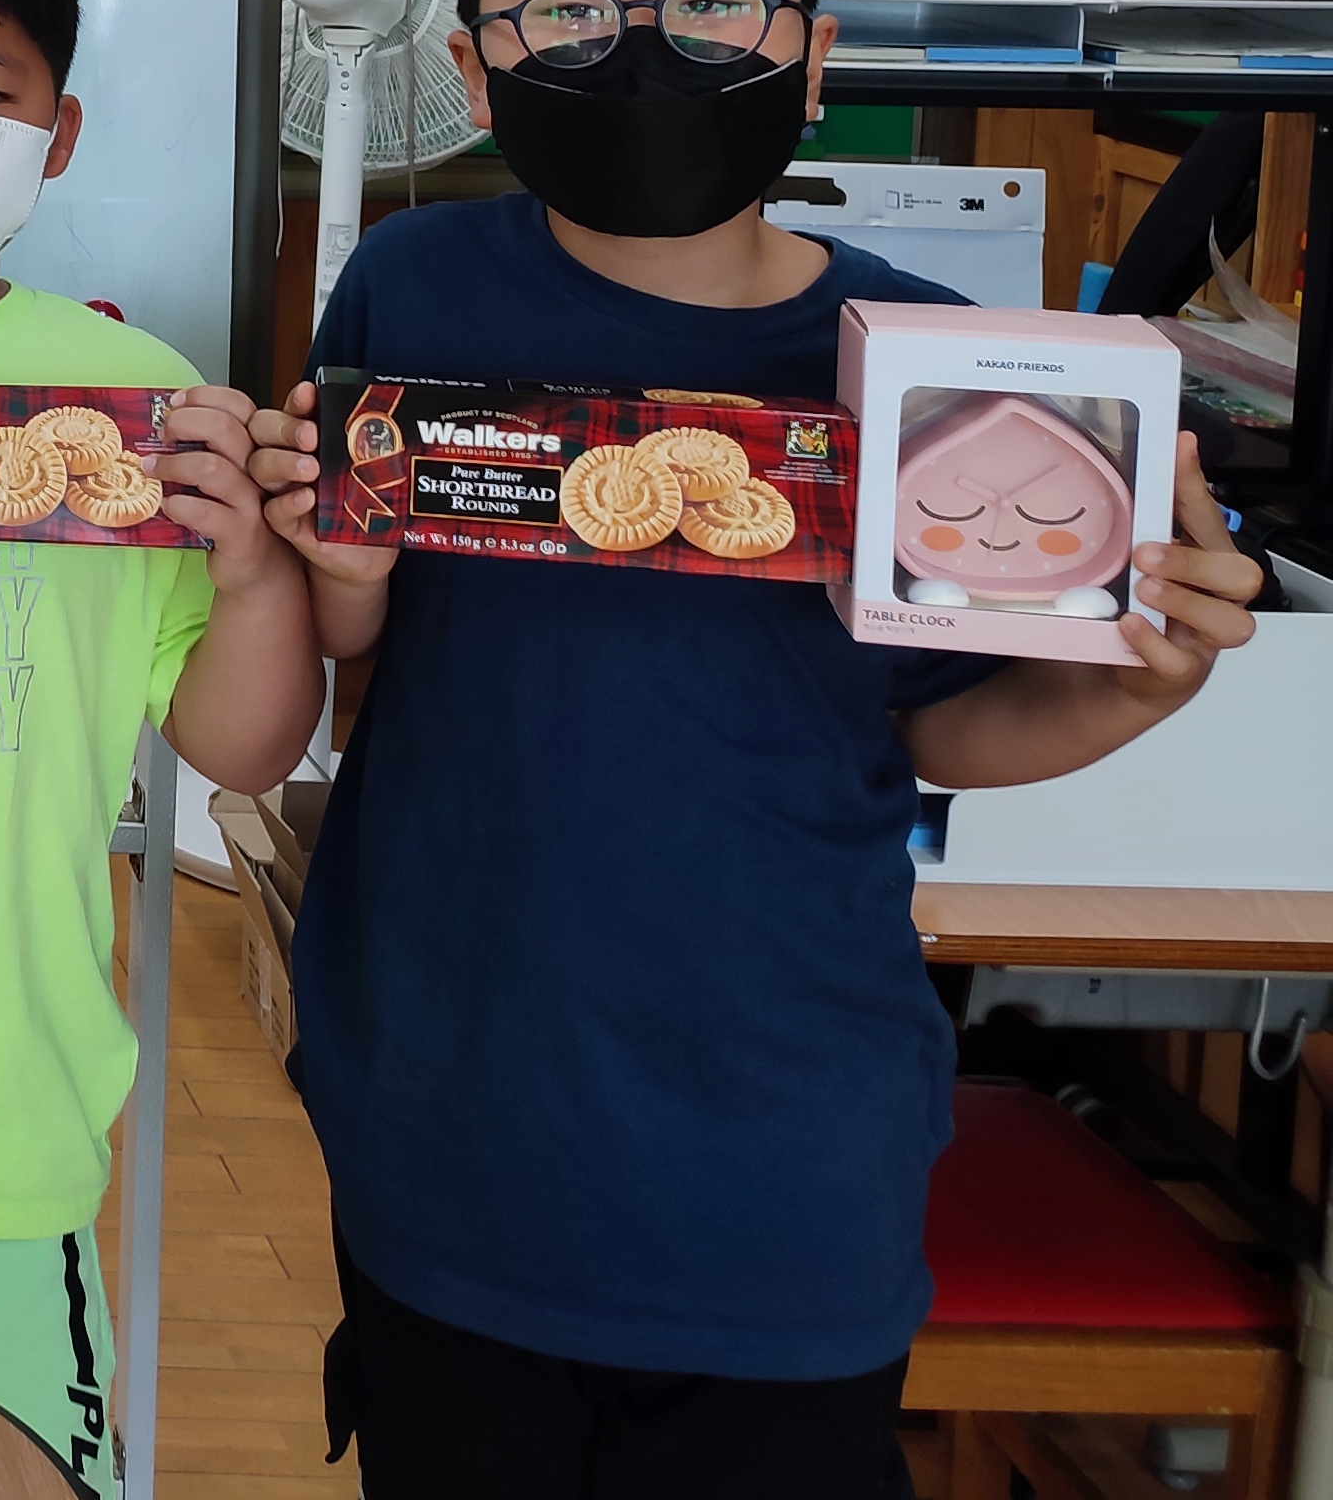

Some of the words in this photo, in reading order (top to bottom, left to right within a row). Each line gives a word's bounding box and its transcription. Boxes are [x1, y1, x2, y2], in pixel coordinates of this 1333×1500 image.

[959, 197, 985, 212] 3M
[976, 359, 1015, 370] KAKAO
[1017, 362, 1065, 374] FRIENDS
[416, 419, 562, 453] Walkers
[451, 464, 481, 480] Pure
[484, 467, 524, 483] Butter
[417, 474, 557, 502] SHORTBREAD
[450, 495, 520, 515] ROUNDS
[403, 529, 426, 544] Net
[863, 608, 906, 623] TABLE
[909, 613, 957, 628] CLOCK
